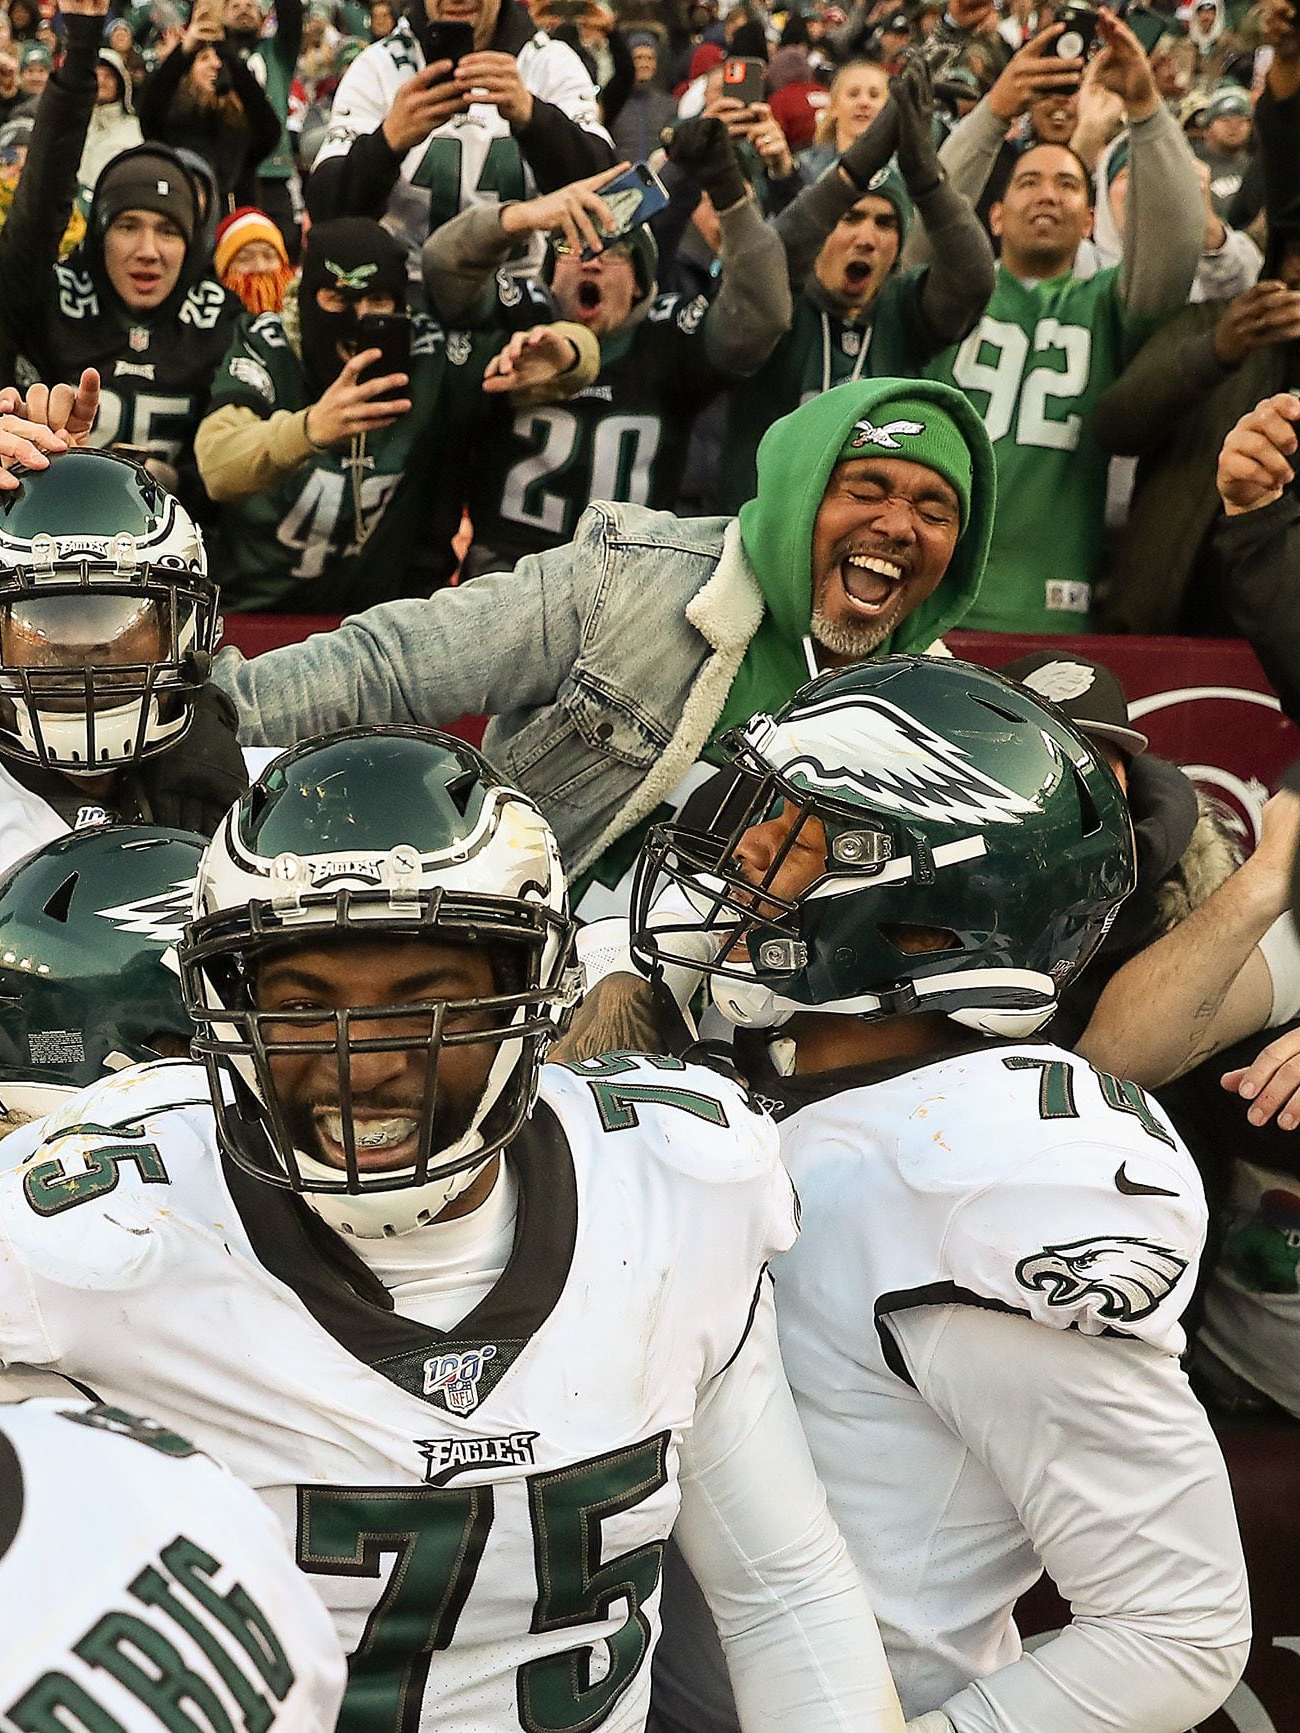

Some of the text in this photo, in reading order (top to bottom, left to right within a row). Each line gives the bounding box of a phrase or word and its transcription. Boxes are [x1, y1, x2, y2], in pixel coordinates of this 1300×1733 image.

[952, 314, 1092, 450] 92
[500, 406, 663, 534] 20
[307, 859, 385, 888] EAGLES
[451, 1390, 474, 1407] NFL
[413, 1431, 541, 1487] EAGLES
[296, 1429, 672, 1733] 75
